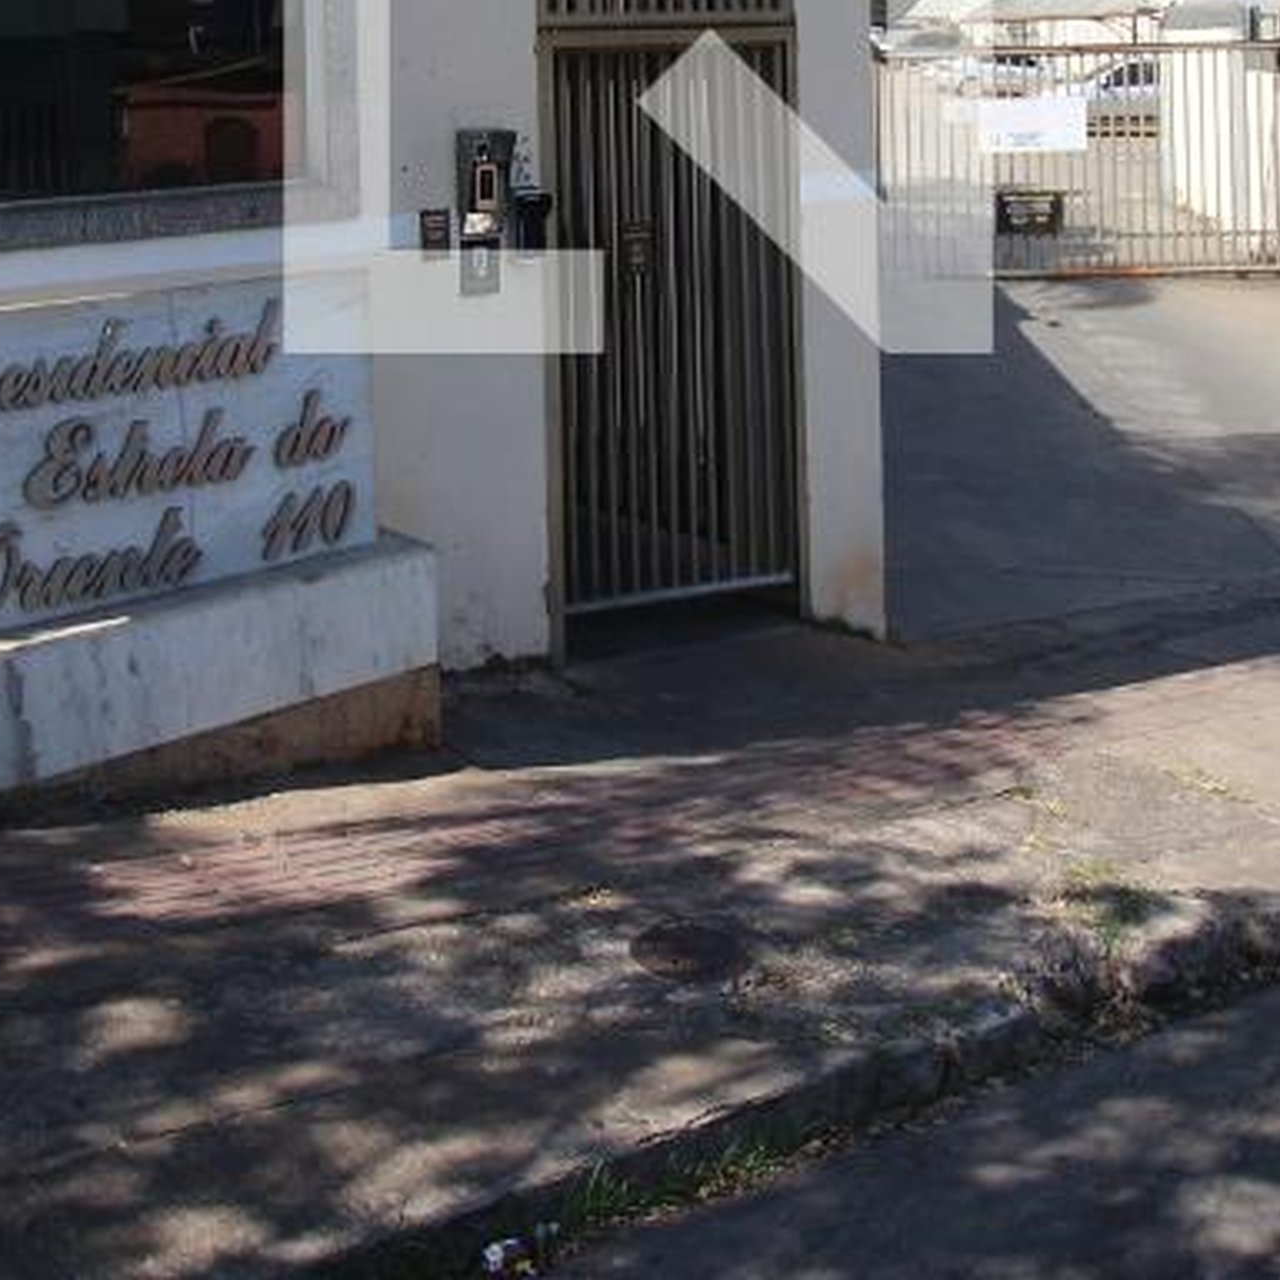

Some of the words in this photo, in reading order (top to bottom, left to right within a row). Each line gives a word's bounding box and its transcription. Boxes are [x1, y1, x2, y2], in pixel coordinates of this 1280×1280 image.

[23, 407, 257, 510] Estrela
[273, 387, 352, 469] do
[261, 479, 355, 561] 110
